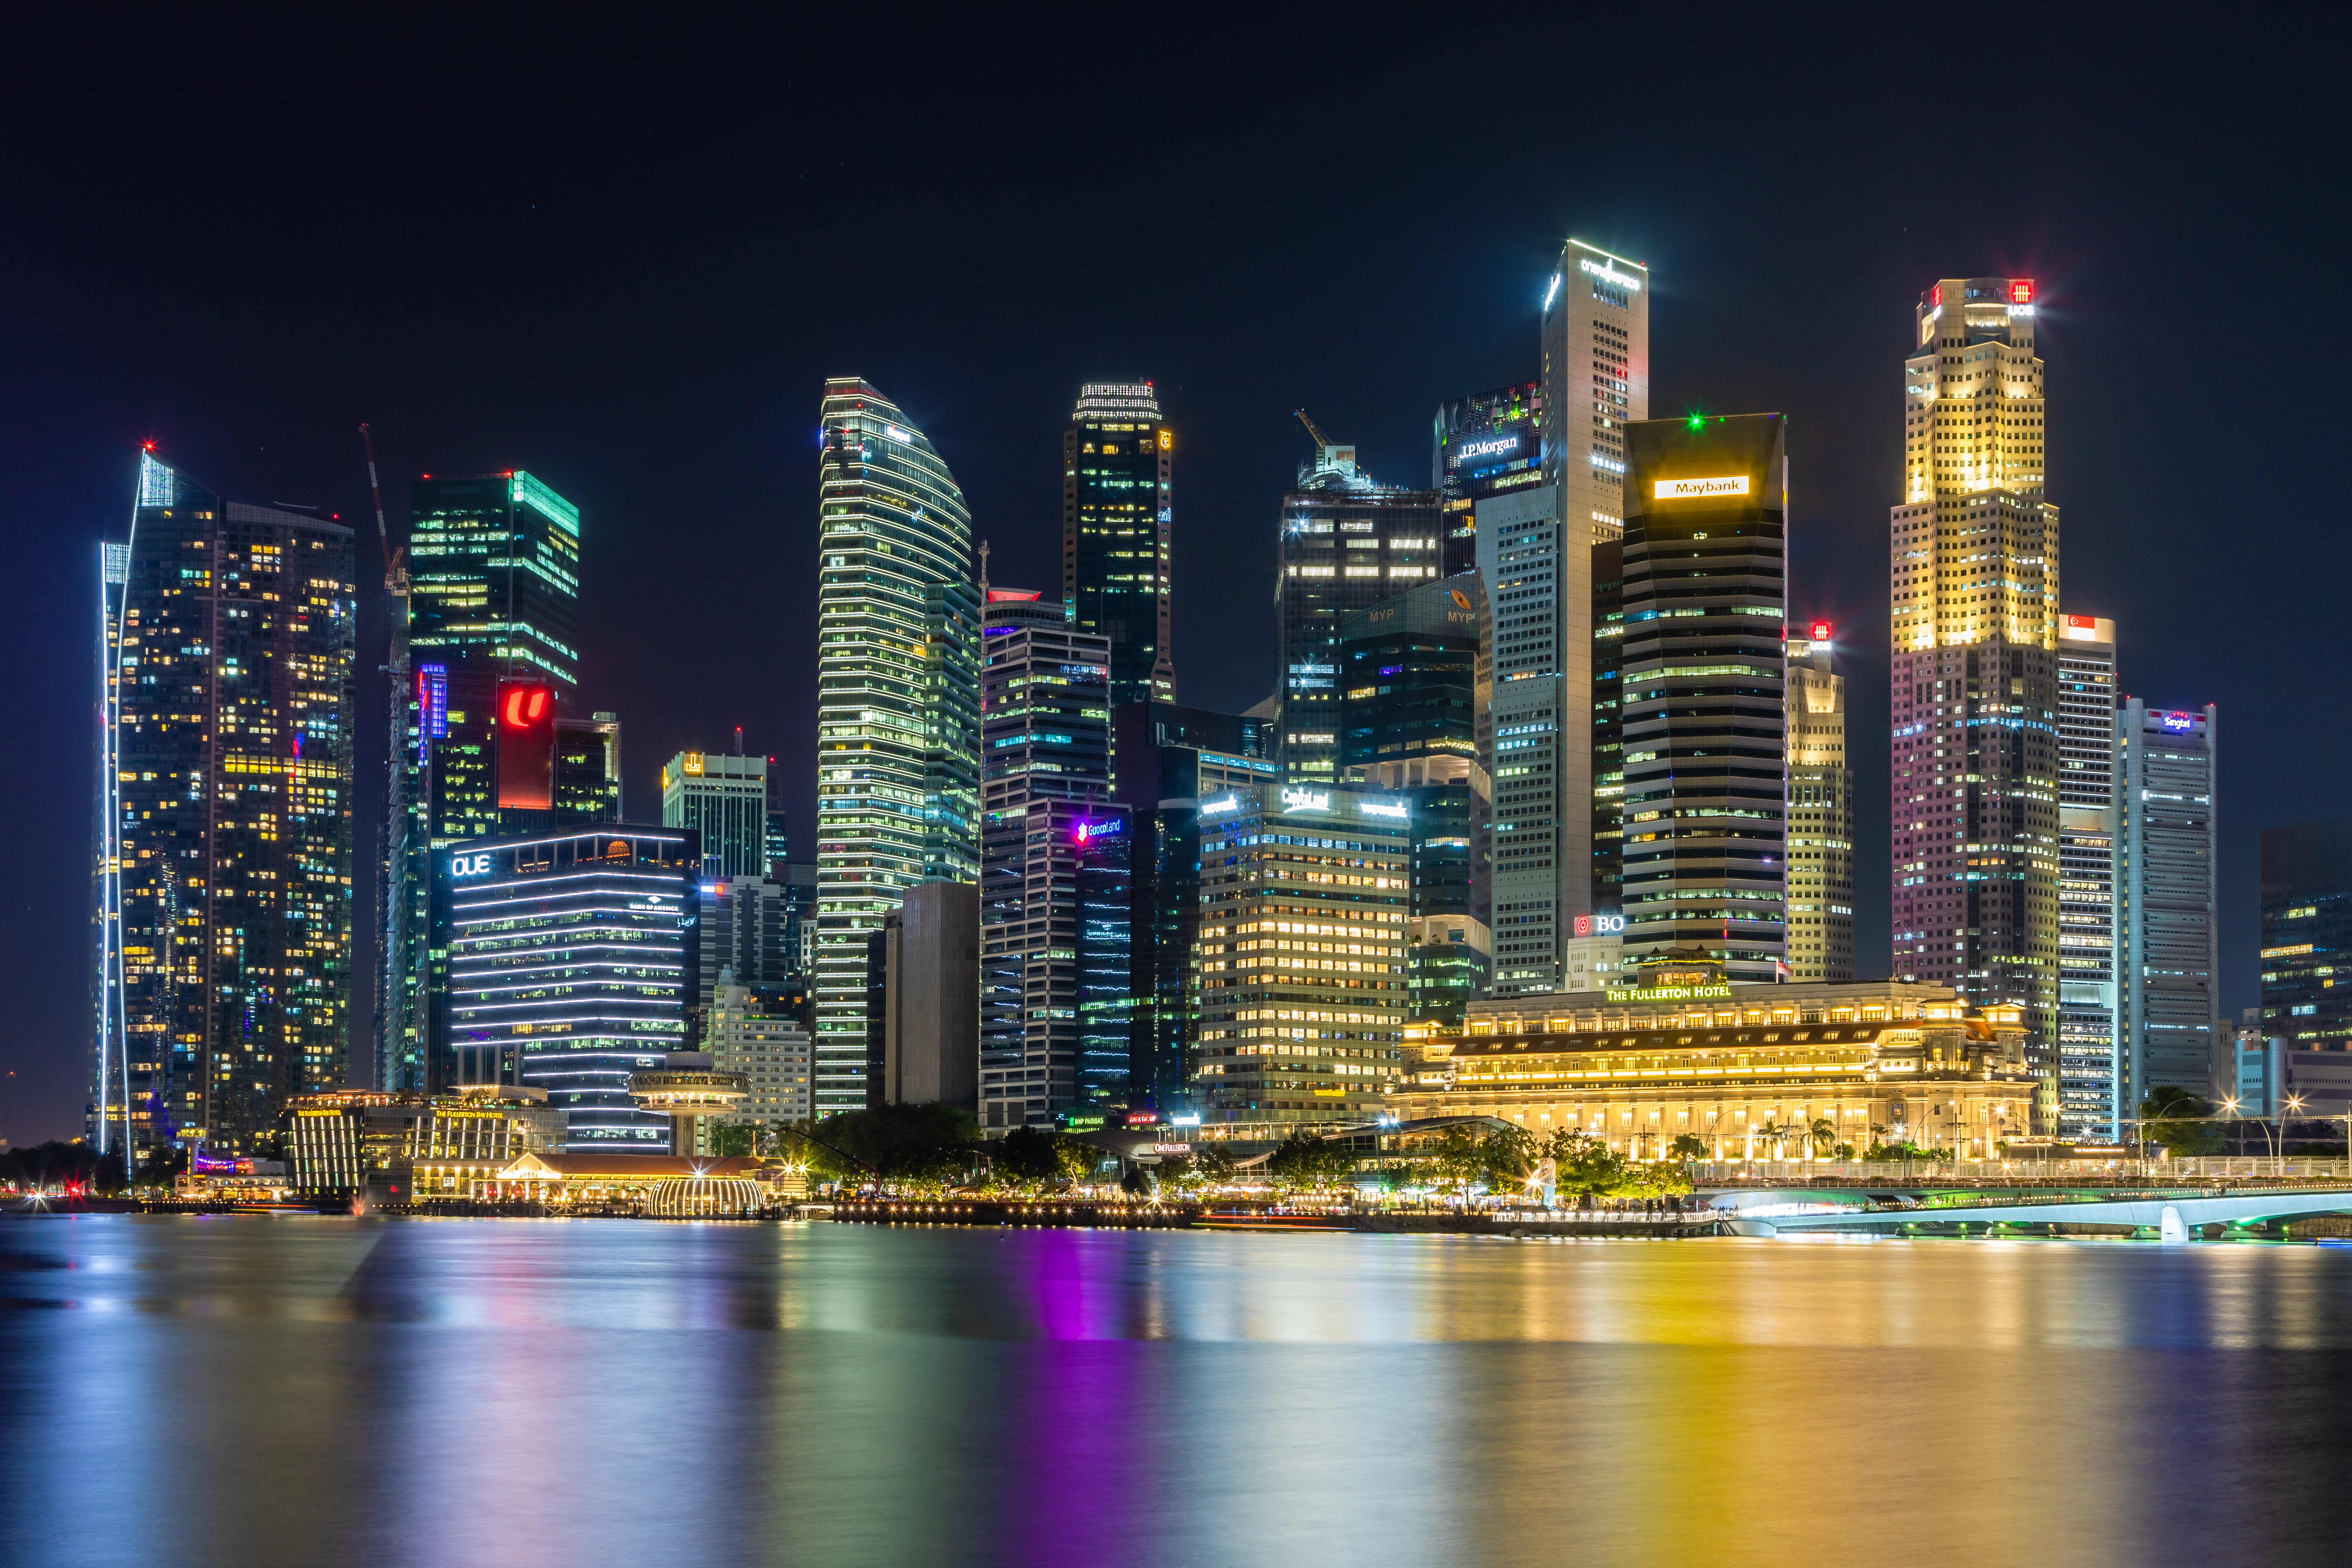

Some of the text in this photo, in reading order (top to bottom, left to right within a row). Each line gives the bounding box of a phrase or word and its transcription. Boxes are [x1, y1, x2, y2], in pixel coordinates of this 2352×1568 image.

[2009, 305, 2034, 316] UOB
[1676, 480, 1739, 495] Maybank
[1370, 609, 1394, 622] MYP
[1448, 611, 1473, 623] MYP
[2165, 717, 2190, 729] Singtel
[1088, 819, 1120, 836] GuocoLand
[453, 855, 490, 876] OUE
[753, 989, 787, 997] ASCOTT
[1607, 986, 1731, 1001] THE FULLERTON HOTEL
